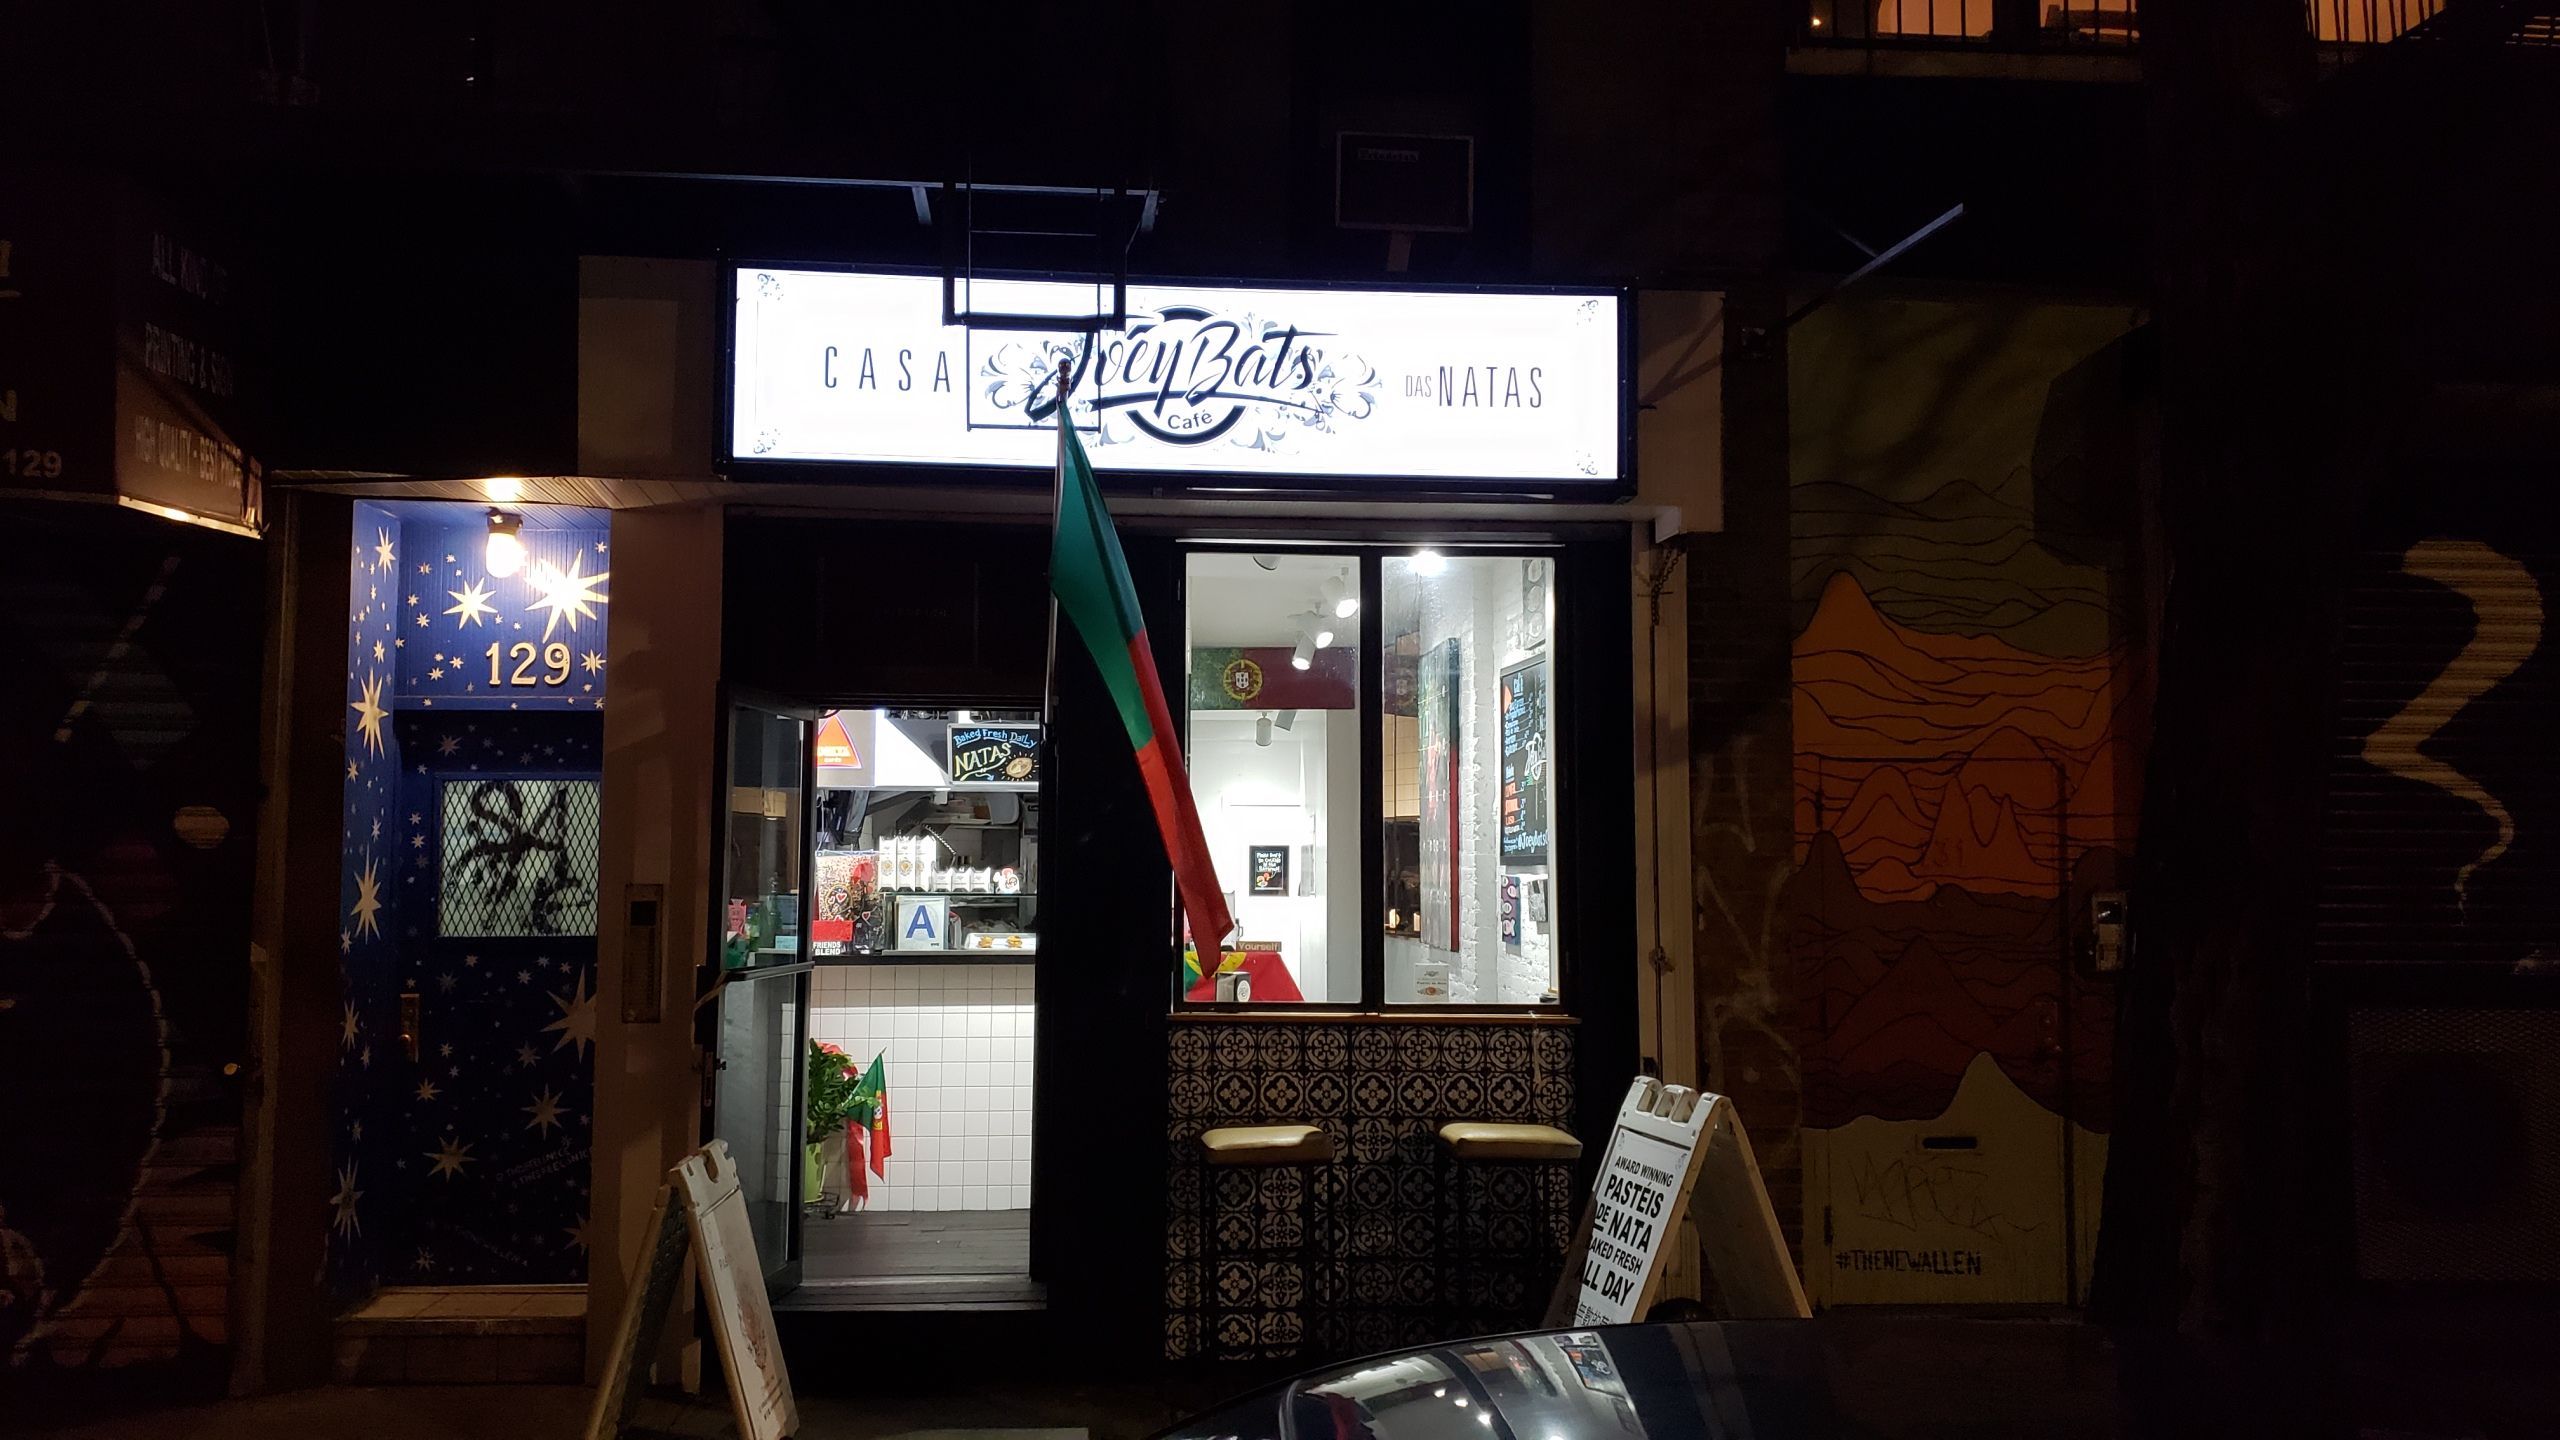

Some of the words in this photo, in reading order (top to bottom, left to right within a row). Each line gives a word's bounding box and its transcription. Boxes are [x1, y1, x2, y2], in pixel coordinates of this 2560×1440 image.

[824, 345, 951, 393] CASA
[1405, 375, 1432, 398] DAS
[1439, 366, 1543, 408] NATAS
[1167, 408, 1213, 430] Café
[2, 449, 62, 478] 129
[486, 641, 572, 686] 129
[953, 729, 981, 746] Baked
[982, 729, 1008, 740] Fresh
[954, 742, 1012, 777] NATAS
[905, 904, 936, 939] A
[1239, 942, 1279, 951] Yourself
[1615, 1156, 1640, 1175] AWARD
[1640, 1164, 1674, 1188] WINNING
[1604, 1174, 1665, 1219] PASTÉIS
[1595, 1203, 1611, 1223] DE
[1608, 1210, 1653, 1254] NATA
[1589, 1237, 1614, 1260] AKED
[1613, 1248, 1643, 1276] FRESH
[1582, 1260, 1601, 1291] LL
[1601, 1270, 1635, 1307] DAY
